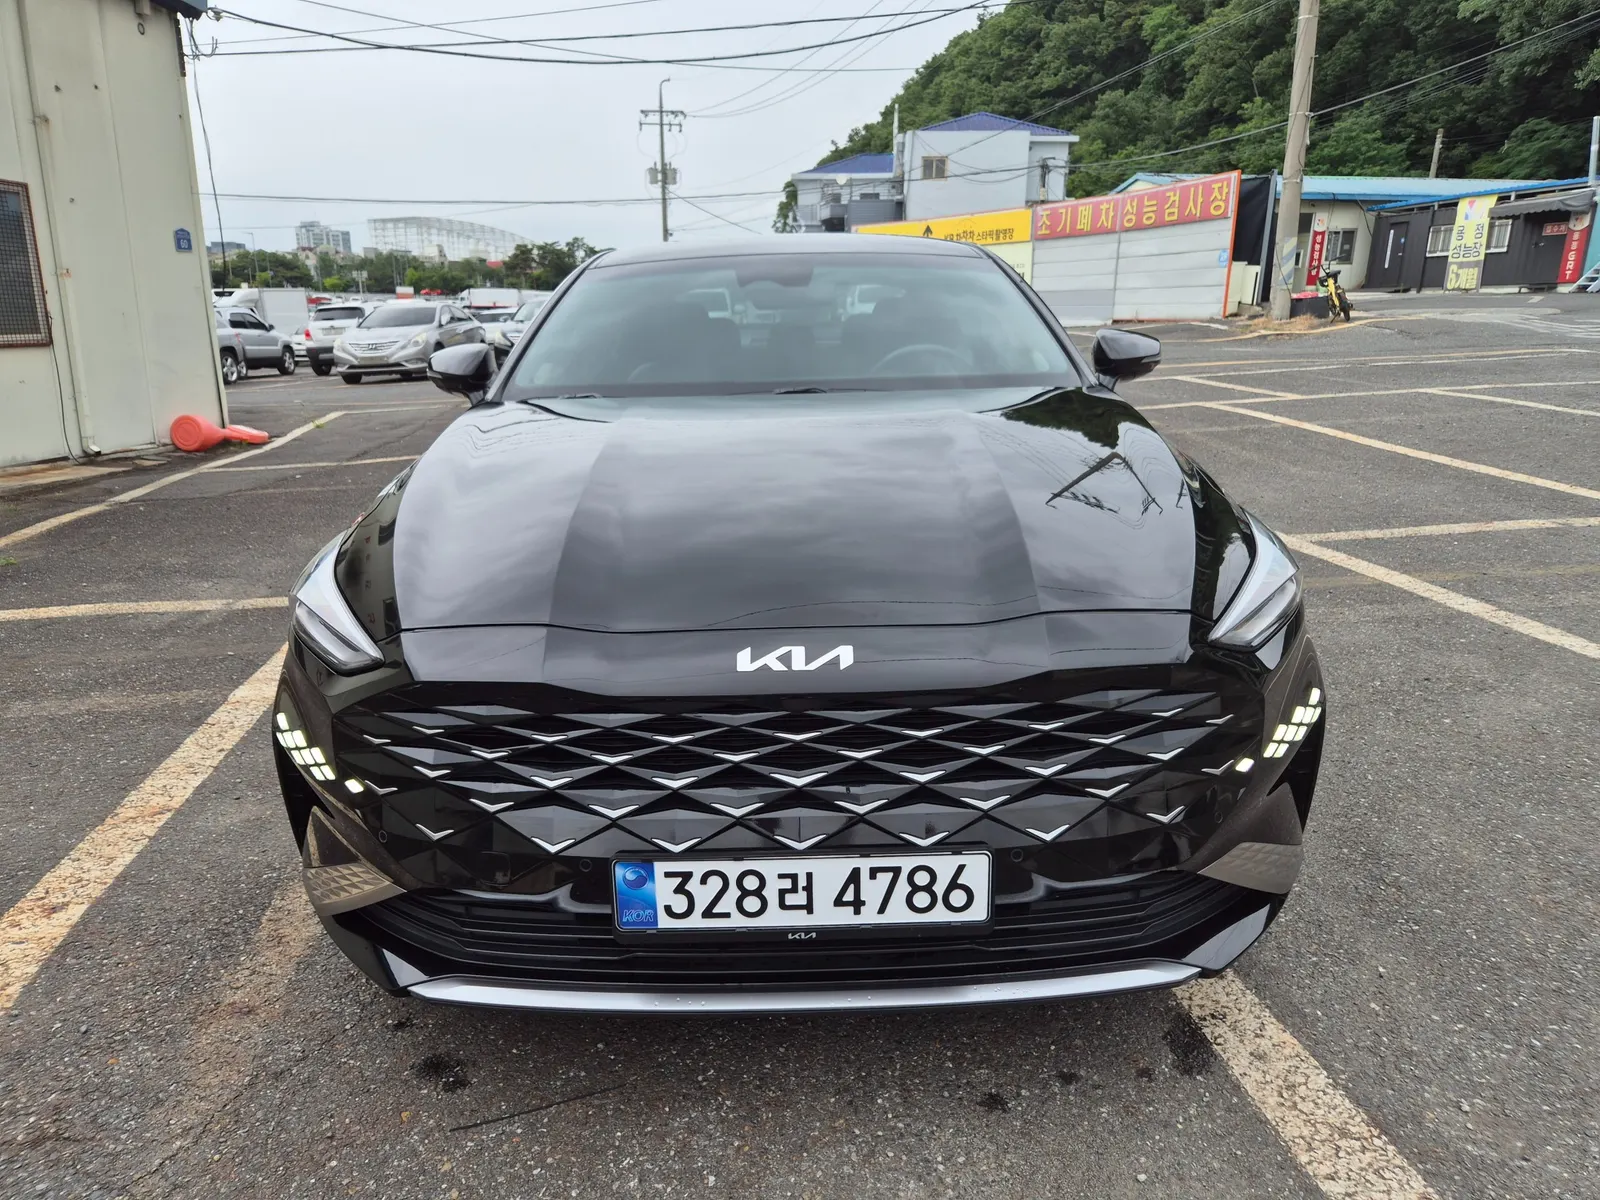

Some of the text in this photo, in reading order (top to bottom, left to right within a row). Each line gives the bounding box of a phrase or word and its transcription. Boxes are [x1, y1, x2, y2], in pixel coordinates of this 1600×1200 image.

[1037, 181, 1230, 235] 조기폐차 성능검사장
[1451, 242, 1483, 259] 성능장
[737, 645, 854, 671] KIA
[663, 863, 975, 920] 328러 4786
[622, 908, 655, 923] KOR
